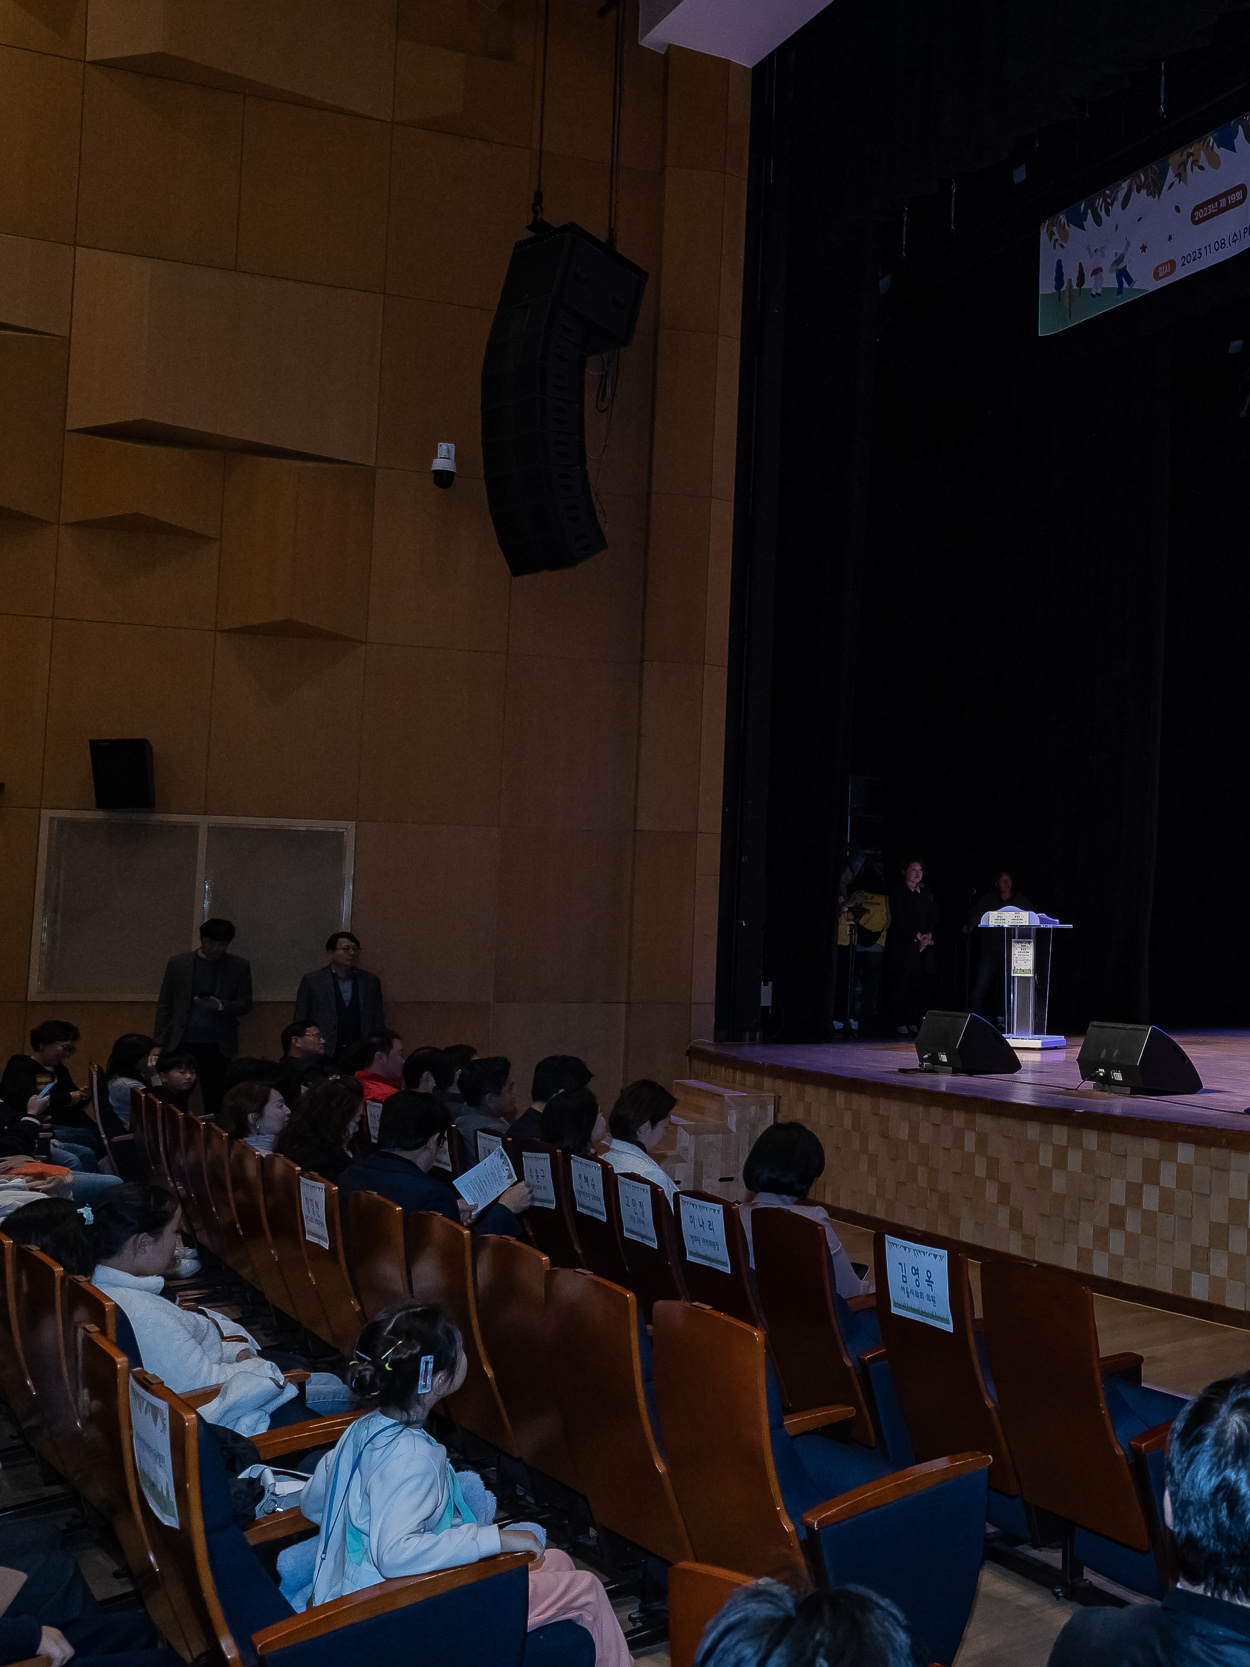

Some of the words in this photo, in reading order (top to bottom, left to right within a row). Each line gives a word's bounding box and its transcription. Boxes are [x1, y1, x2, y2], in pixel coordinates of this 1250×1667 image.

[1194, 202, 1218, 221] 2023년
[1219, 197, 1227, 206] 제
[1228, 189, 1243, 205] 19회
[1158, 263, 1171, 277] 일시
